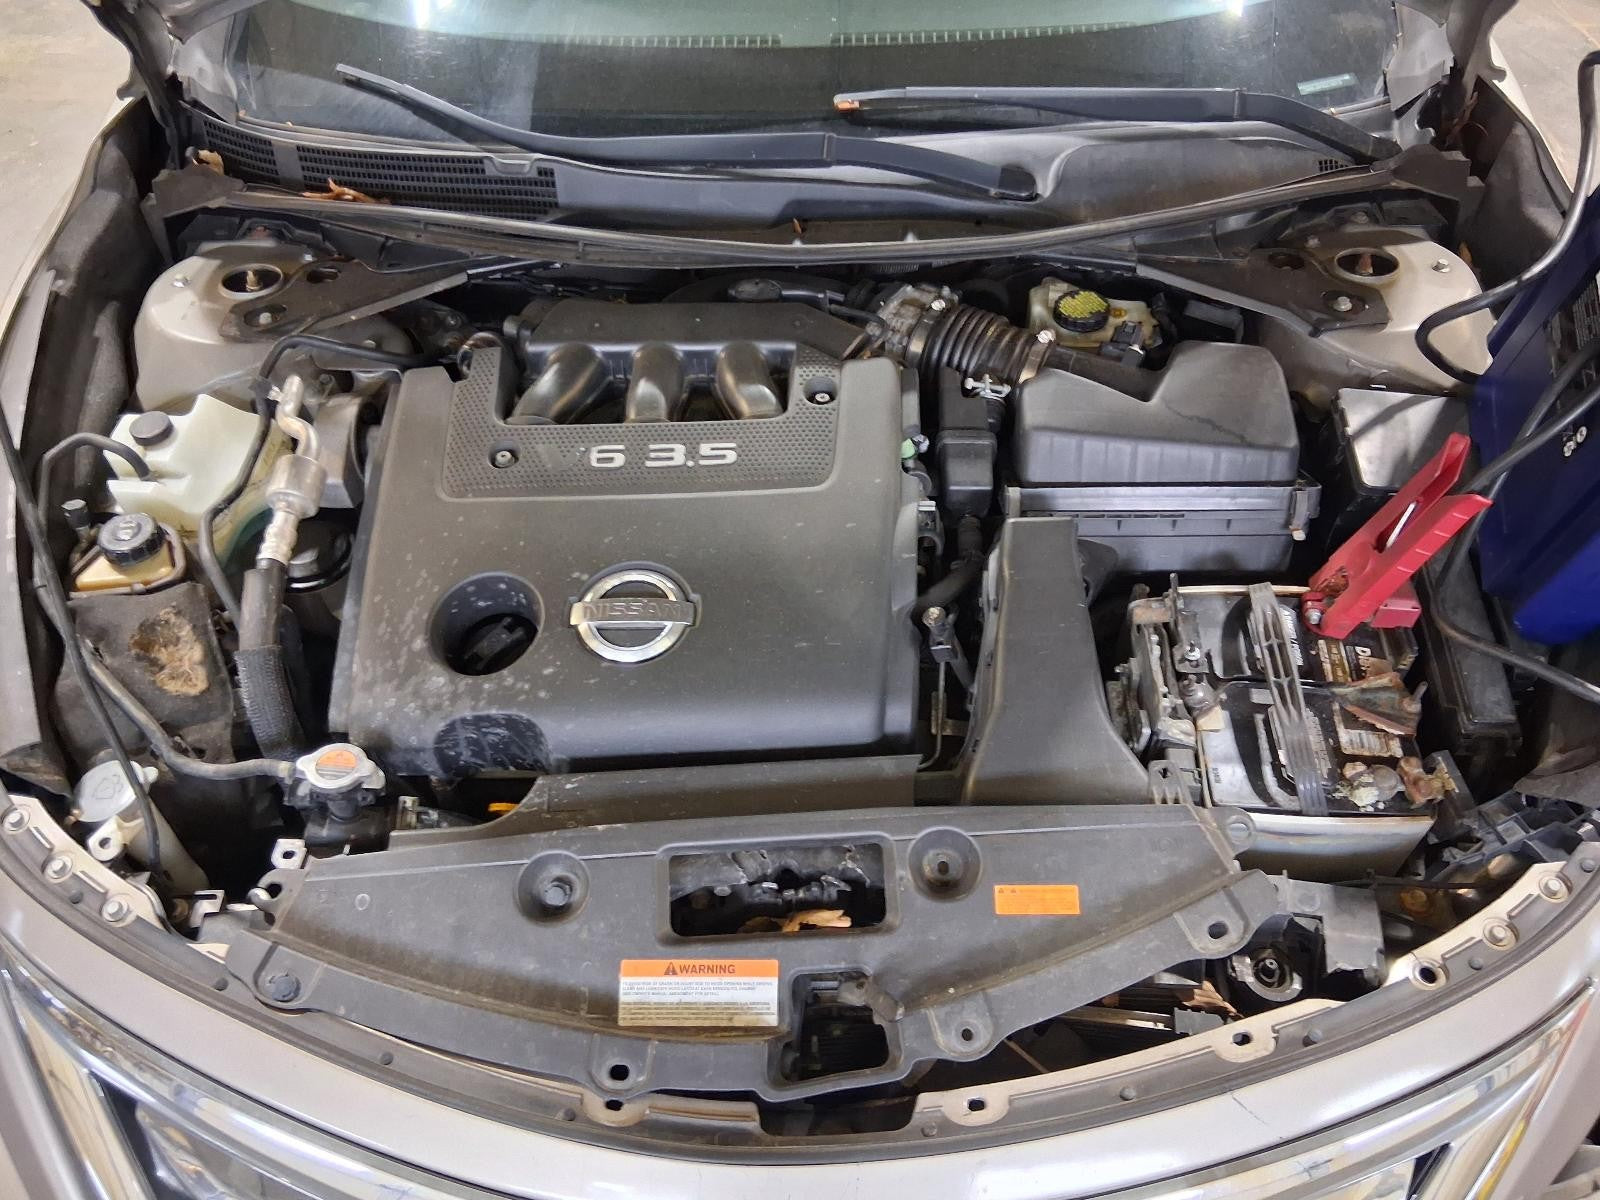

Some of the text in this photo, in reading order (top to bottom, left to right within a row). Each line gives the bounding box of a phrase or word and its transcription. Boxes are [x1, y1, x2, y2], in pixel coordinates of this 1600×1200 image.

[645, 442, 738, 468] 3.5
[583, 602, 683, 618] NISSAN
[679, 963, 736, 975] WARNING
